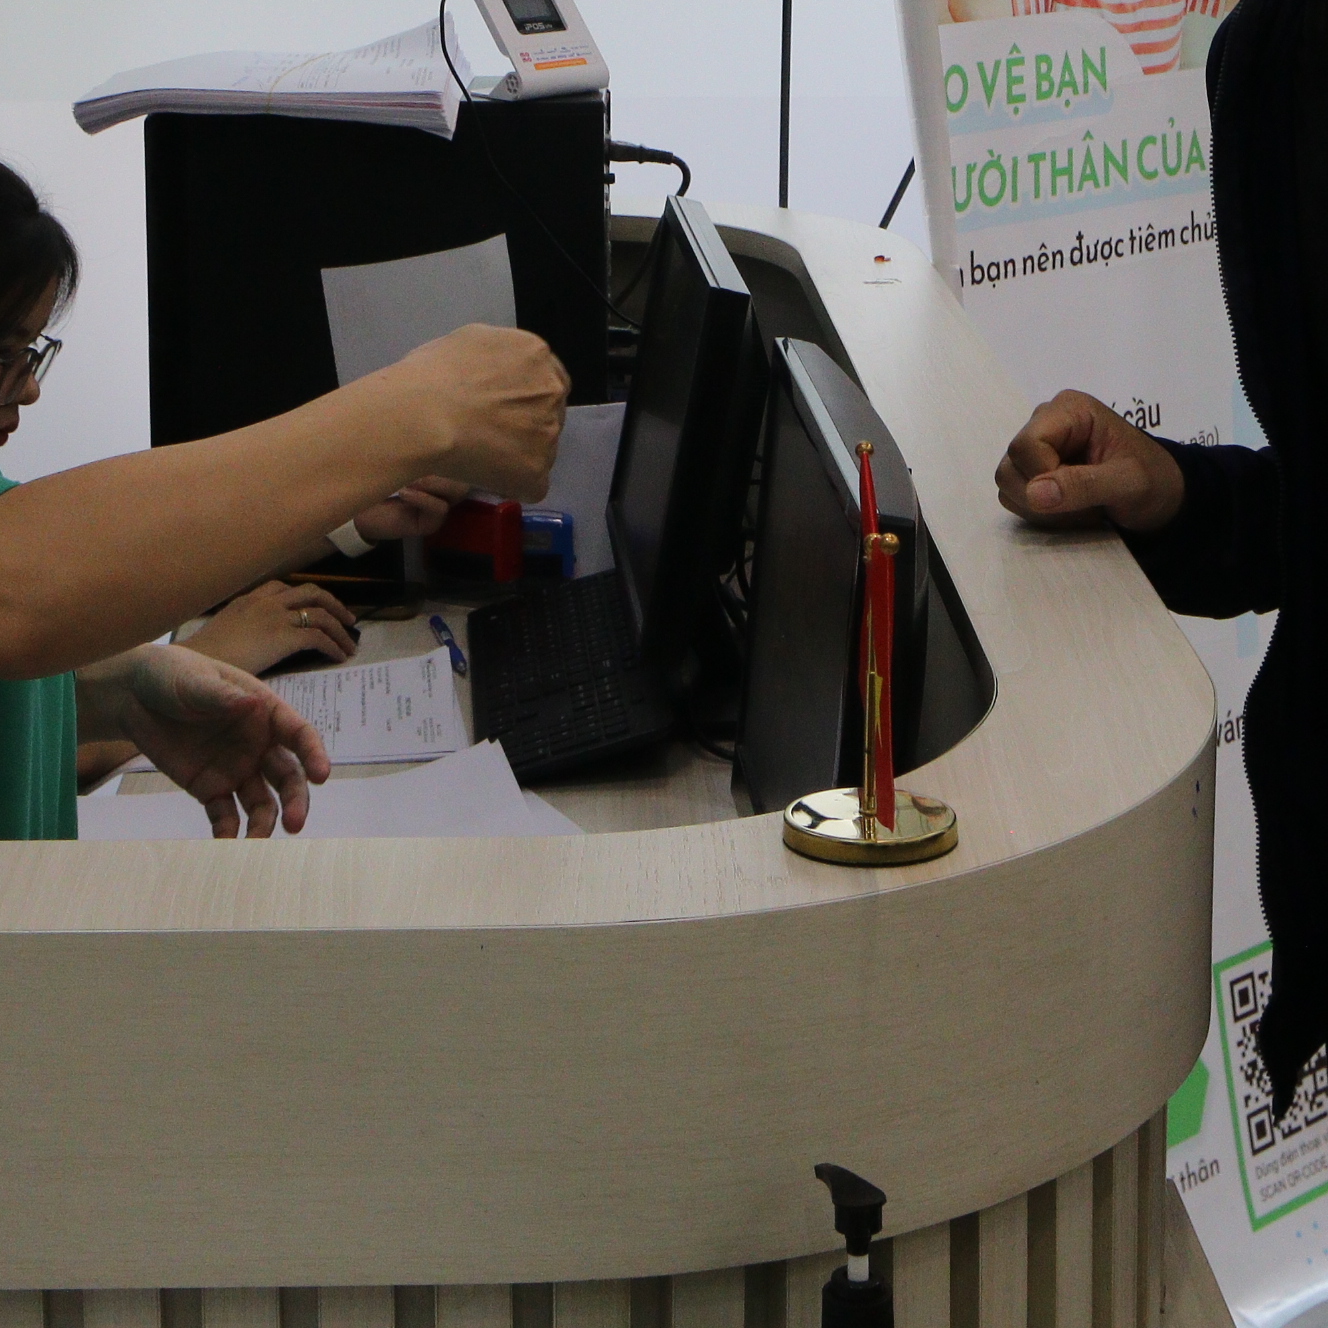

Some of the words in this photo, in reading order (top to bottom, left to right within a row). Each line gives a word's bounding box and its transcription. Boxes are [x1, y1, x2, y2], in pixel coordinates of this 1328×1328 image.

[977, 42, 1027, 116] VỆ
[1035, 46, 1108, 109] BẠN
[1027, 129, 1129, 201] THÂN
[1136, 117, 1207, 182] CỦA
[971, 251, 1017, 288] bạn
[1022, 242, 1065, 277] nên
[1069, 230, 1125, 268] được
[1128, 222, 1176, 256] tiêm
[1180, 1157, 1221, 1194] thân
